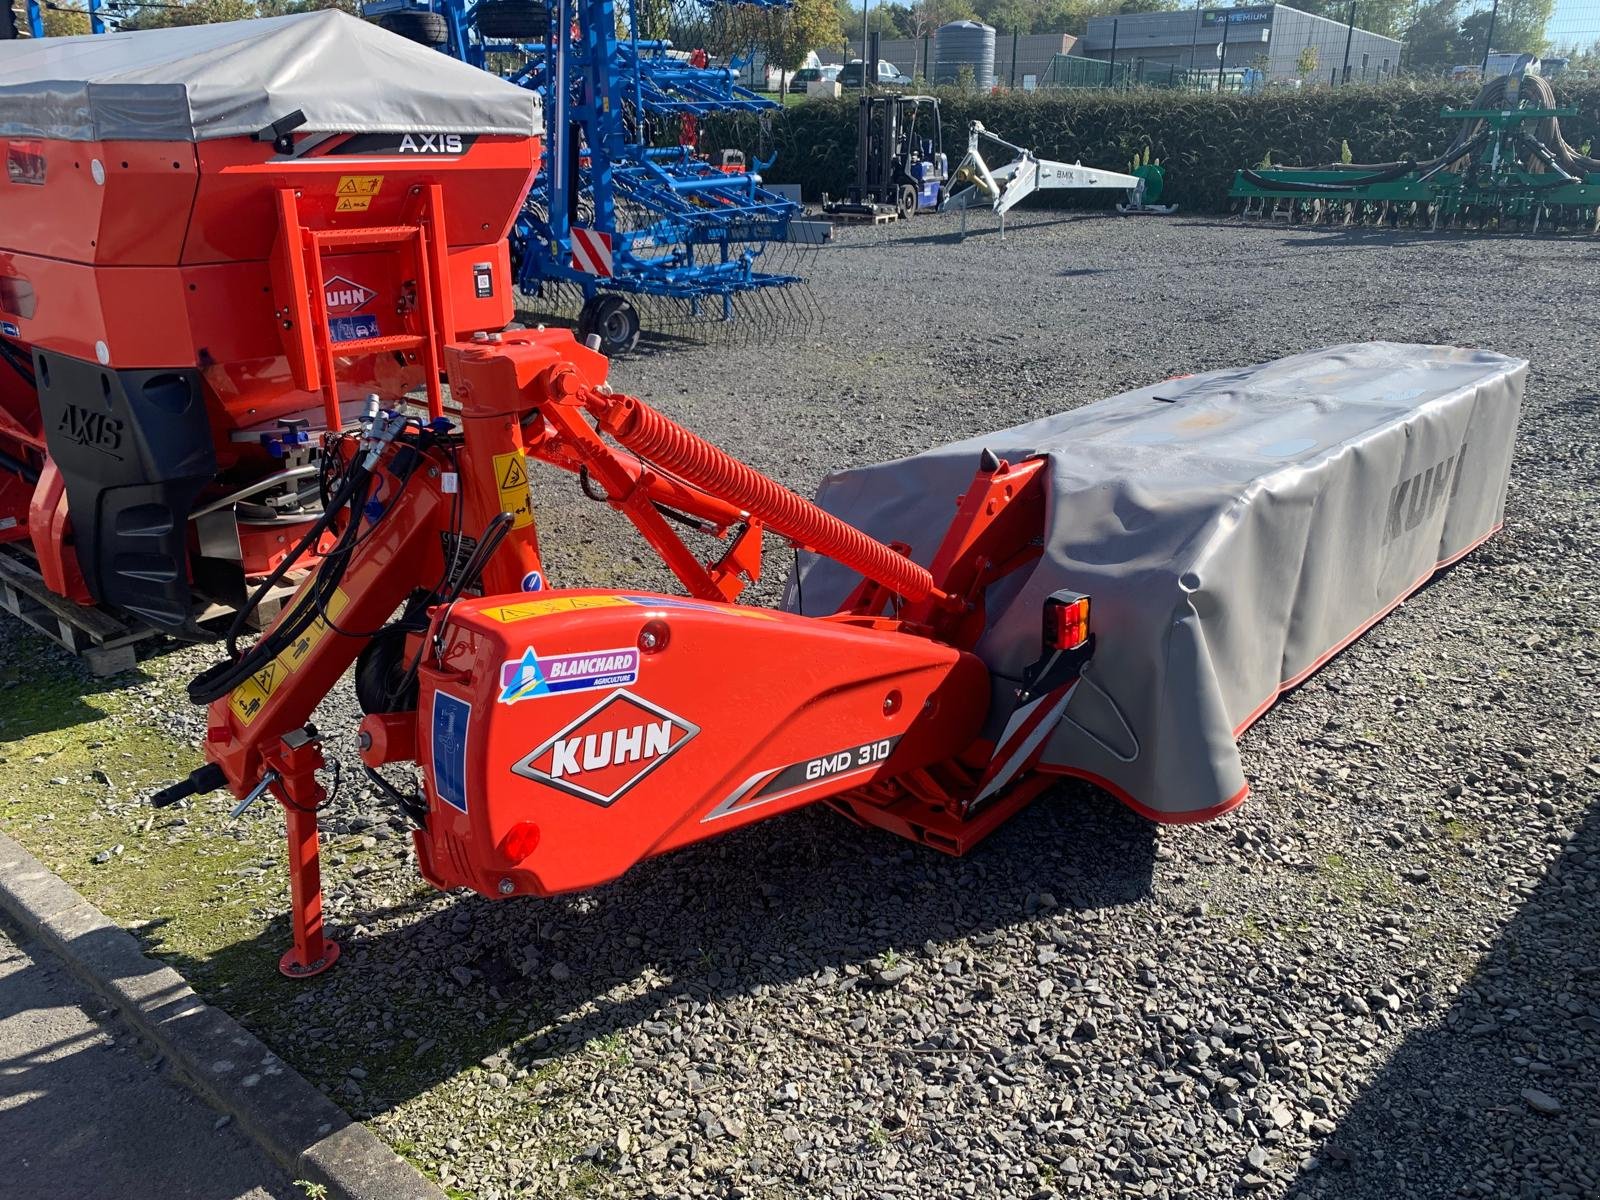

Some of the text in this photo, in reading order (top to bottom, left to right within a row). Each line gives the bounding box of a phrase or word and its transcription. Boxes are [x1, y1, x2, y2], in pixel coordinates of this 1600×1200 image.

[398, 133, 463, 153] AXIS
[326, 288, 365, 307] UHN
[58, 403, 124, 450] AXIS
[550, 654, 633, 678] BLANCHARD
[593, 674, 631, 686] AGRICULTURE
[551, 719, 672, 779] KUHN
[805, 740, 890, 780] GMD 310
